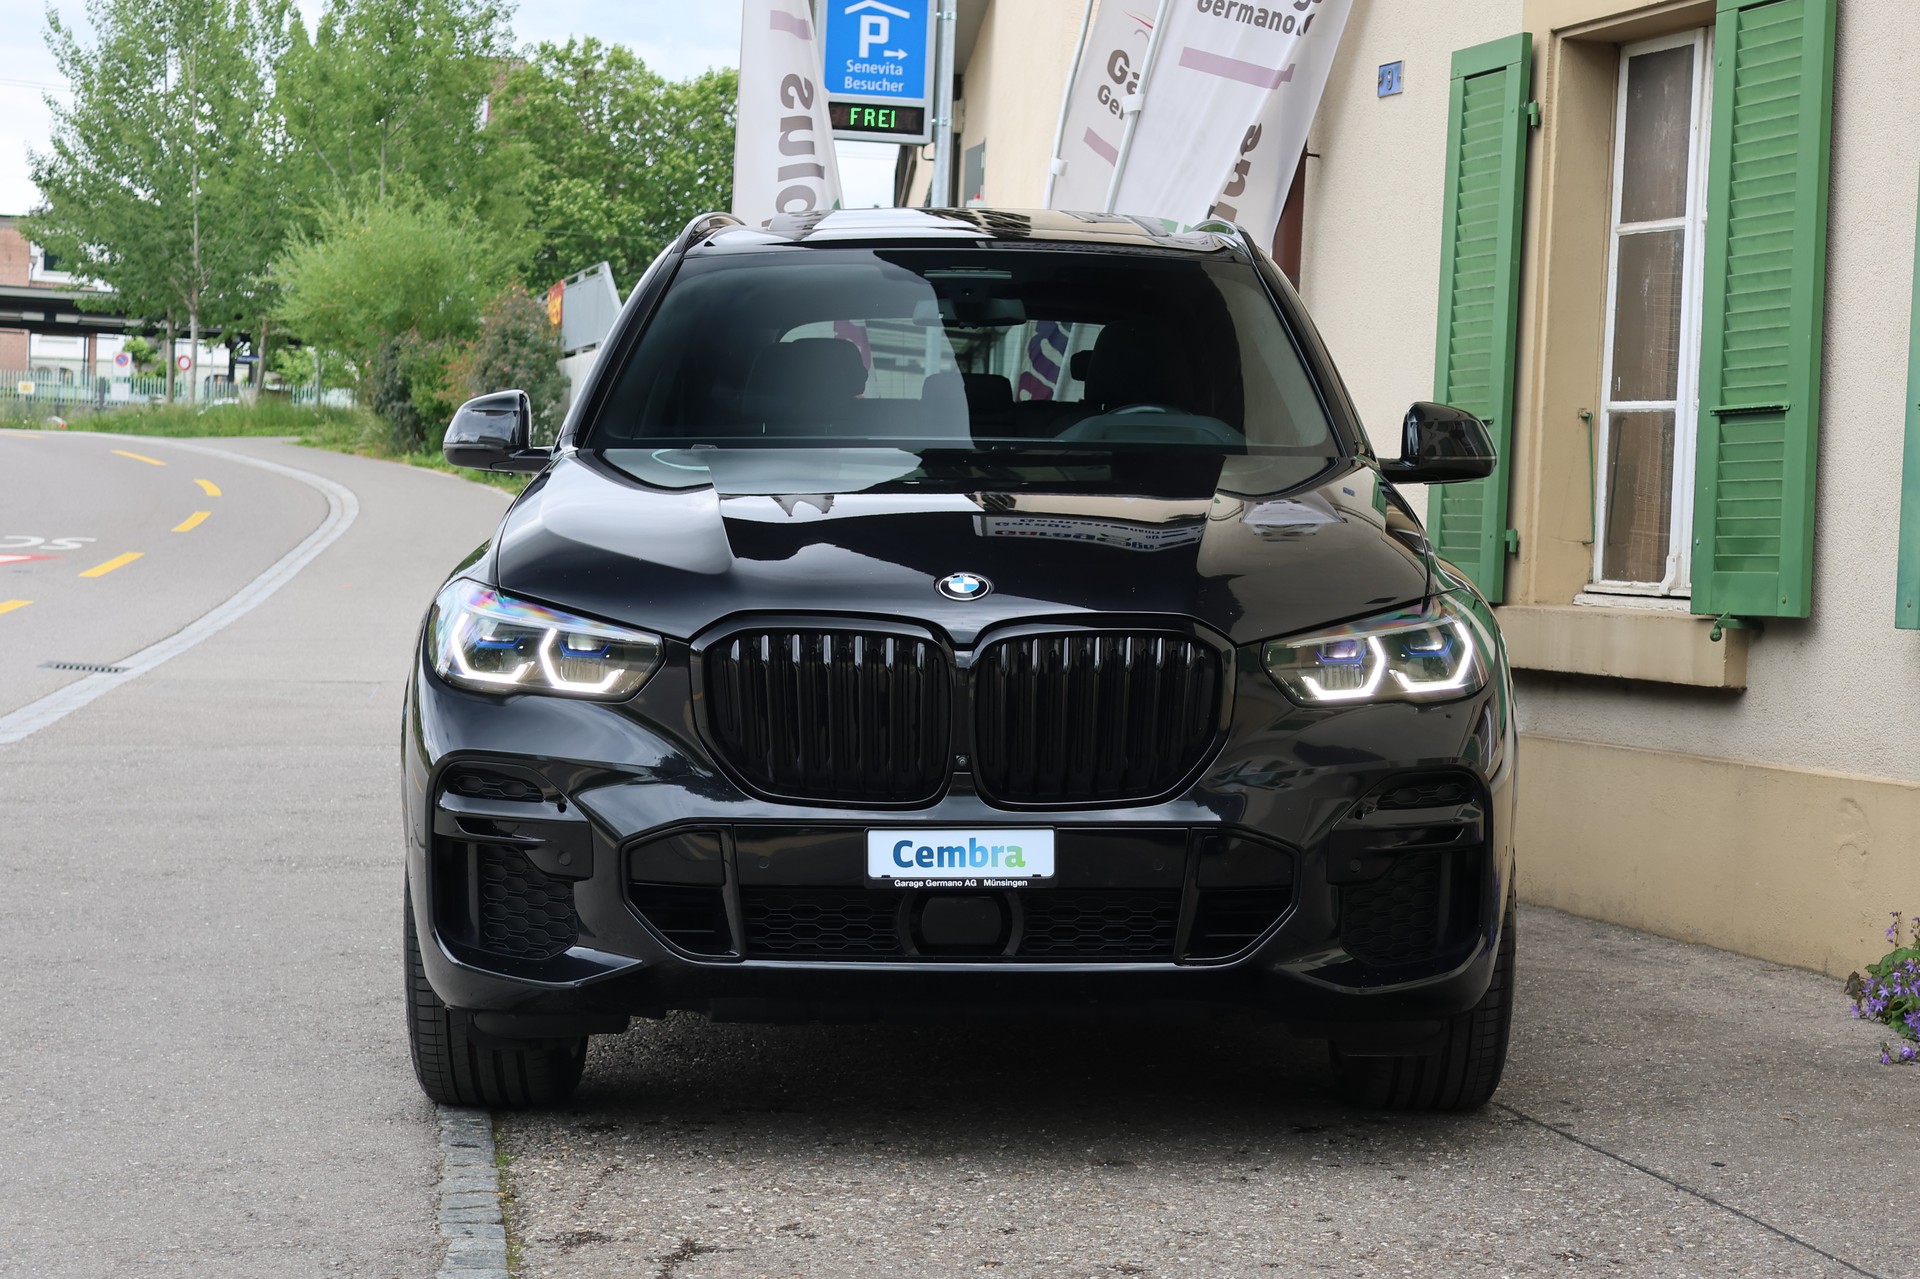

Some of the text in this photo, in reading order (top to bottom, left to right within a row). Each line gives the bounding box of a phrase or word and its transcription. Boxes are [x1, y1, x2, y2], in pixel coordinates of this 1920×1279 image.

[1196, 0, 1296, 34] Germano
[858, 14, 890, 58] P
[846, 59, 903, 76] Senevita
[844, 76, 904, 92] Besucher
[850, 107, 896, 128] FREI
[892, 837, 1026, 868] Cembra
[894, 880, 924, 888] Garage
[983, 879, 1028, 888] Münsingen
